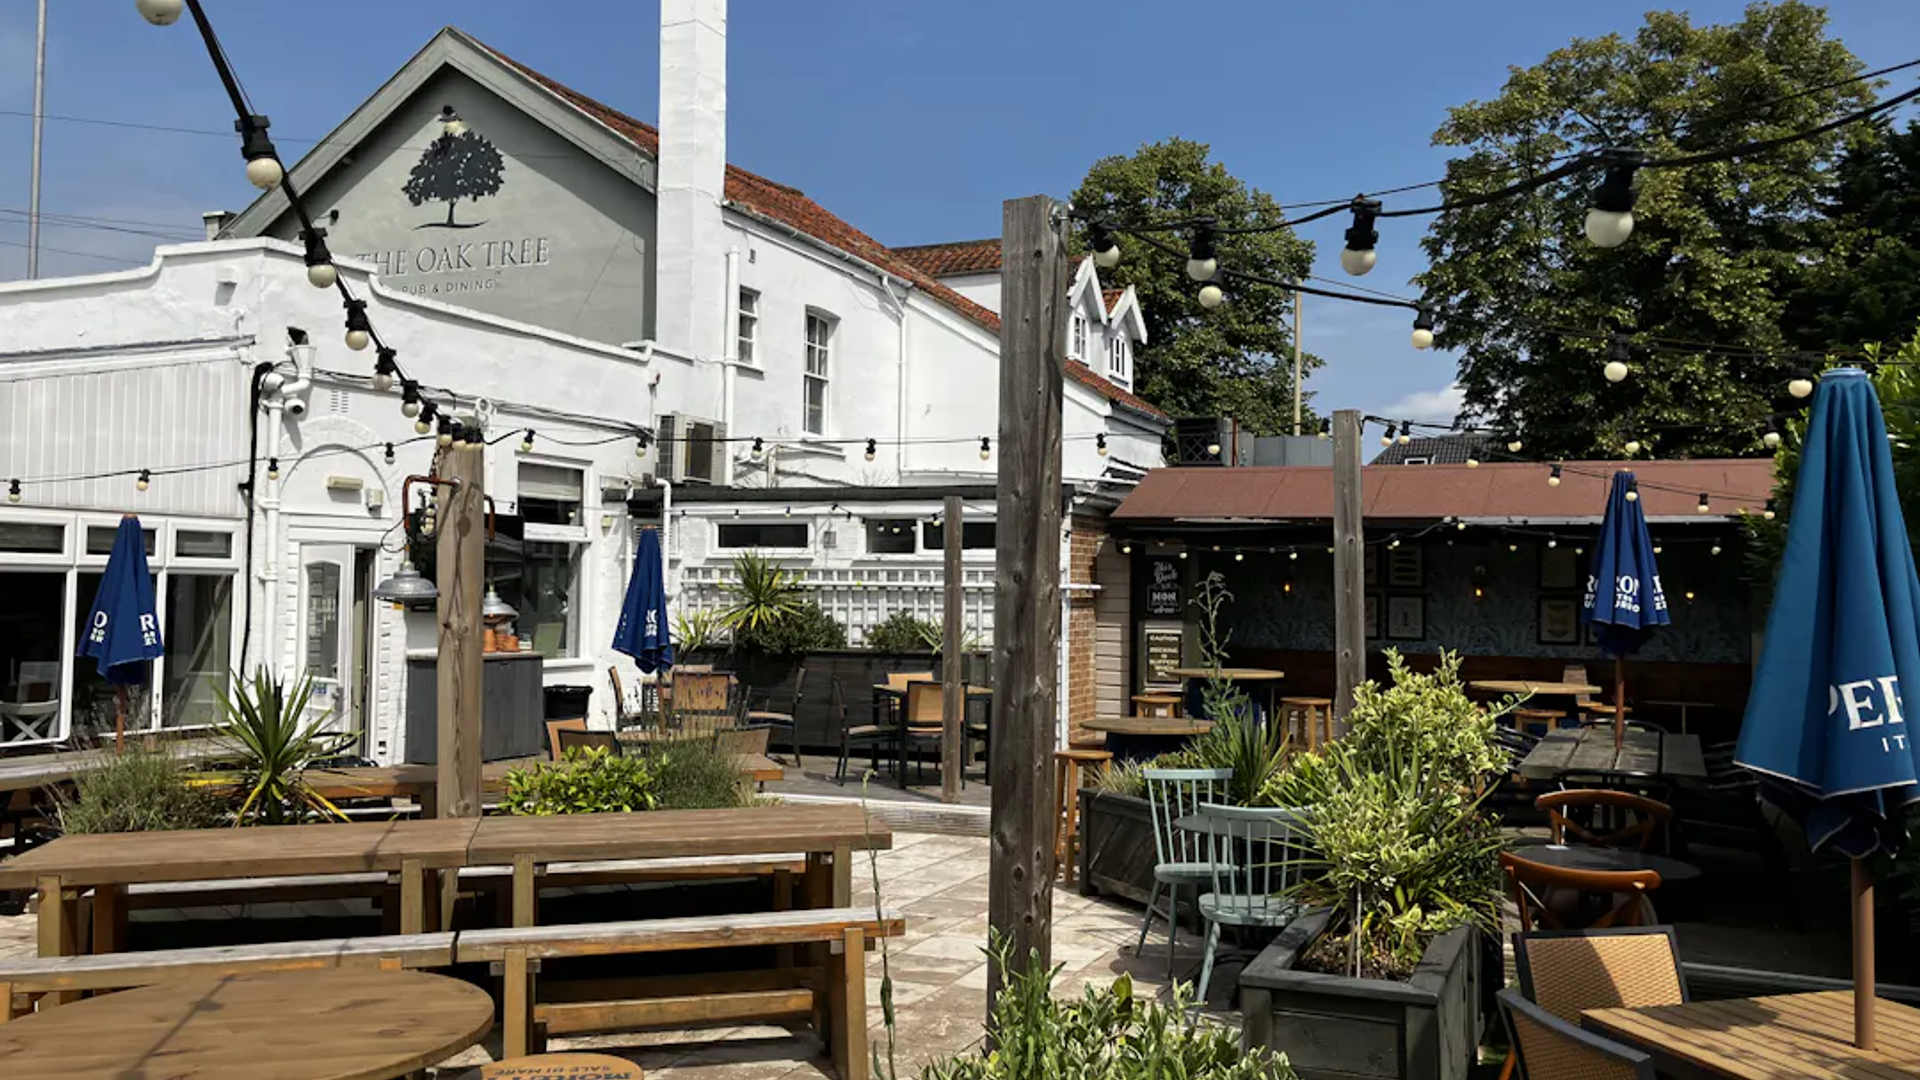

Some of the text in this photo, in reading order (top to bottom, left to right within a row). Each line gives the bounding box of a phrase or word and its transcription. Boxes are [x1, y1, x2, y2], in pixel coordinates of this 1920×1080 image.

[415, 243, 474, 274] OAK
[482, 237, 549, 267] TREE
[432, 285, 440, 294] &
[446, 279, 493, 293] DINING
